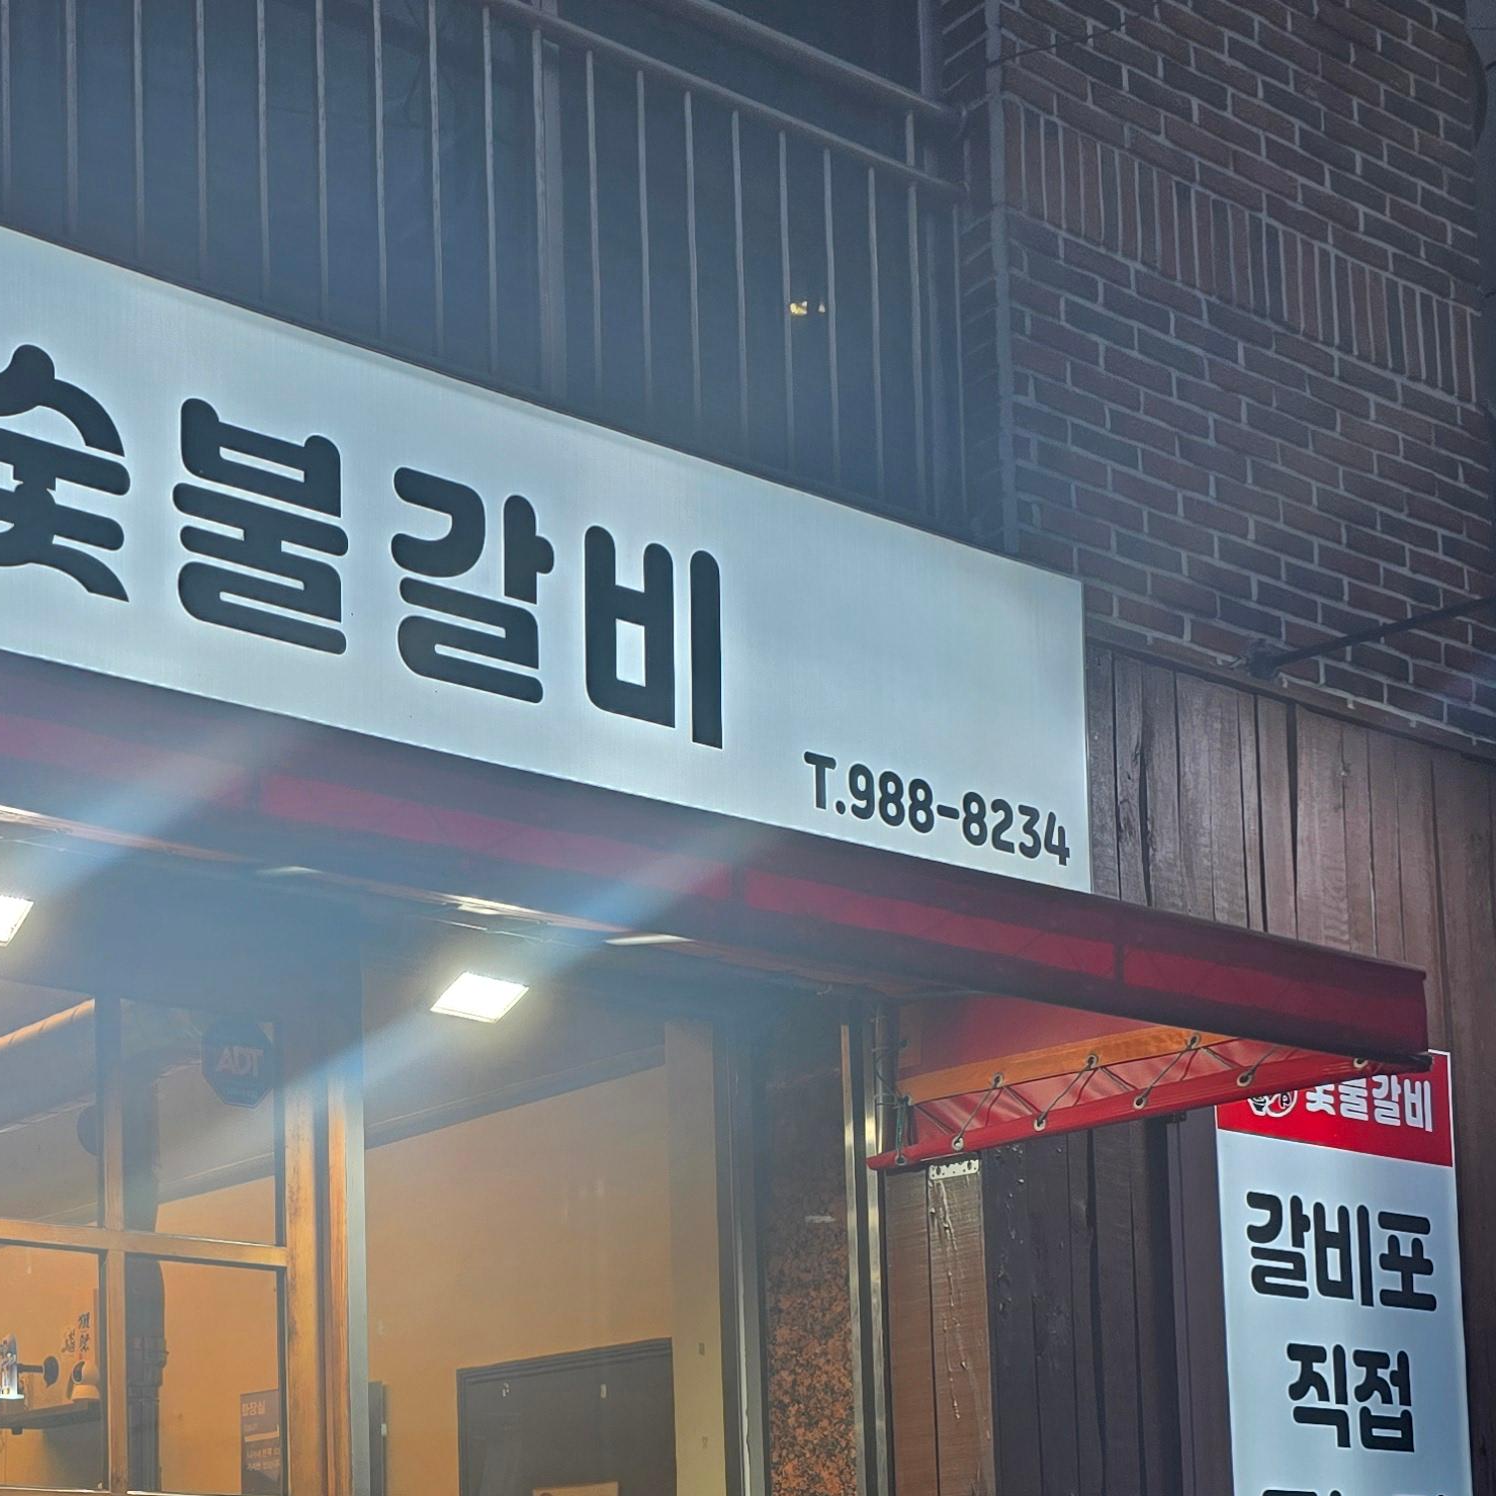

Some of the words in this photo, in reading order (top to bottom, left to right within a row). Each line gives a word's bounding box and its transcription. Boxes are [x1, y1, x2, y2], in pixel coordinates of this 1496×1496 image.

[803, 750, 1071, 867] T.988-8234
[215, 1045, 264, 1077] ADT
[1245, 1190, 1437, 1312] 갈비포
[1286, 1342, 1415, 1453] 직접
